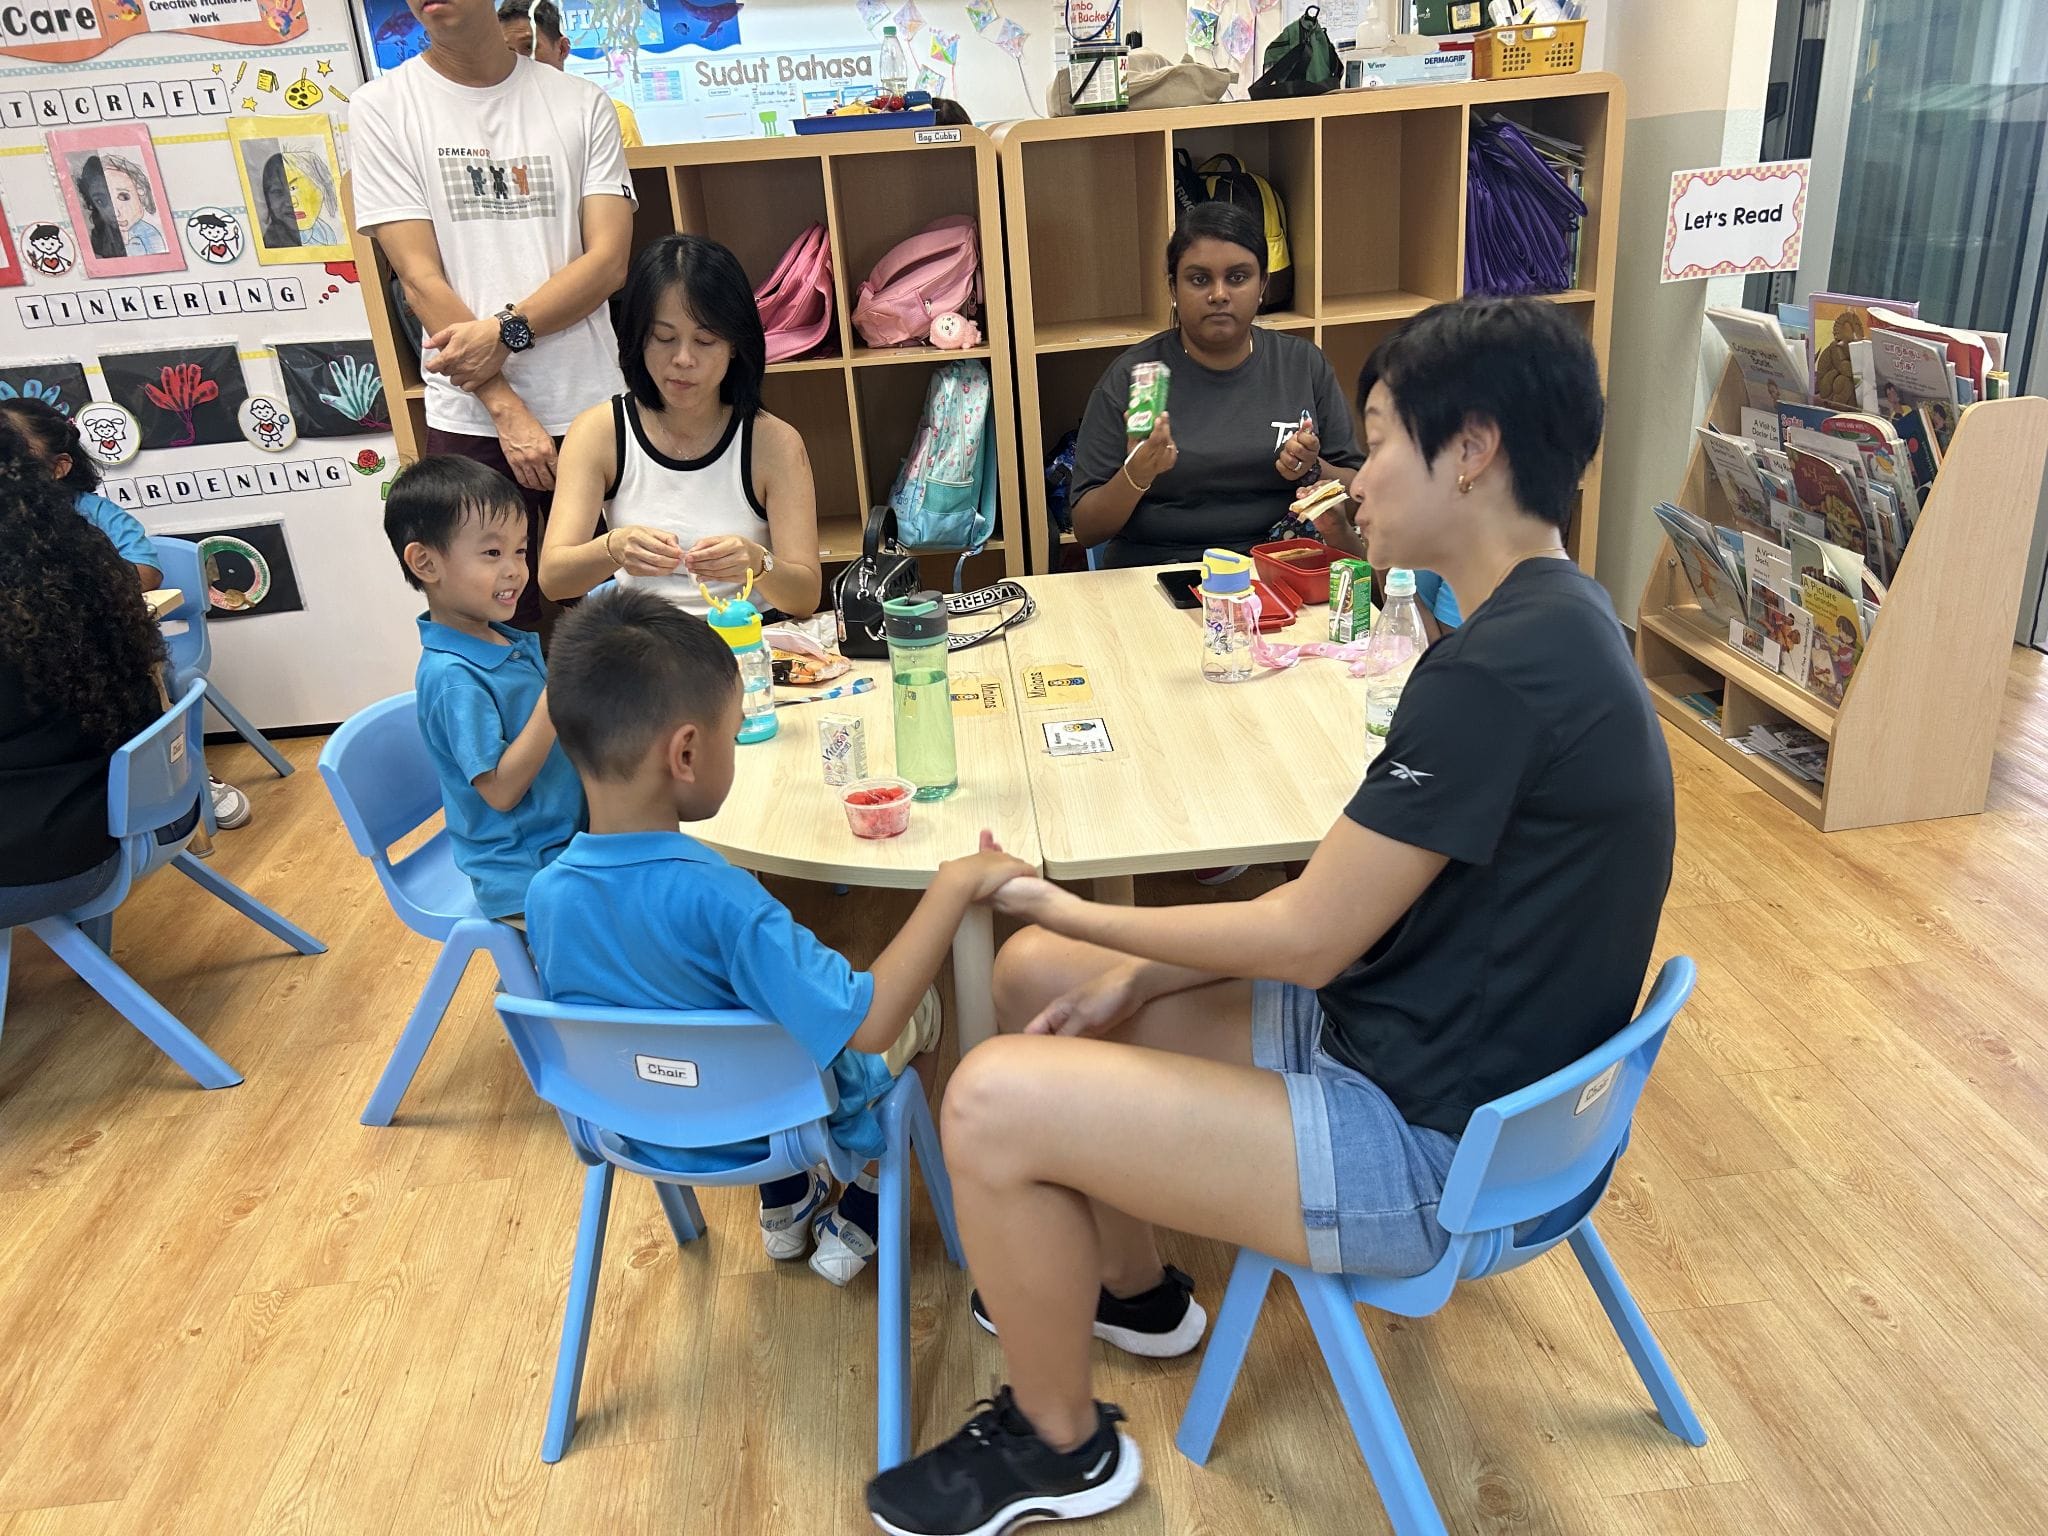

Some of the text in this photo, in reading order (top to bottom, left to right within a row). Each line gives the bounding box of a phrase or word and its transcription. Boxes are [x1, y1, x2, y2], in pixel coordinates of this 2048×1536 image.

[2, 6, 96, 36] Care
[189, 11, 220, 24] Work
[695, 54, 873, 87] Sudut Bahasa
[1424, 54, 1466, 65] DERMAGRIP
[918, 131, 958, 142] Bag Cubby
[1684, 203, 1784, 231] Let's Read
[27, 286, 295, 320] TINKERING
[1752, 426, 1769, 439] Doctor
[97, 465, 341, 503] ARDENING
[981, 682, 1001, 709] Minions
[1028, 671, 1047, 699] Minions
[648, 1063, 687, 1078] Chair
